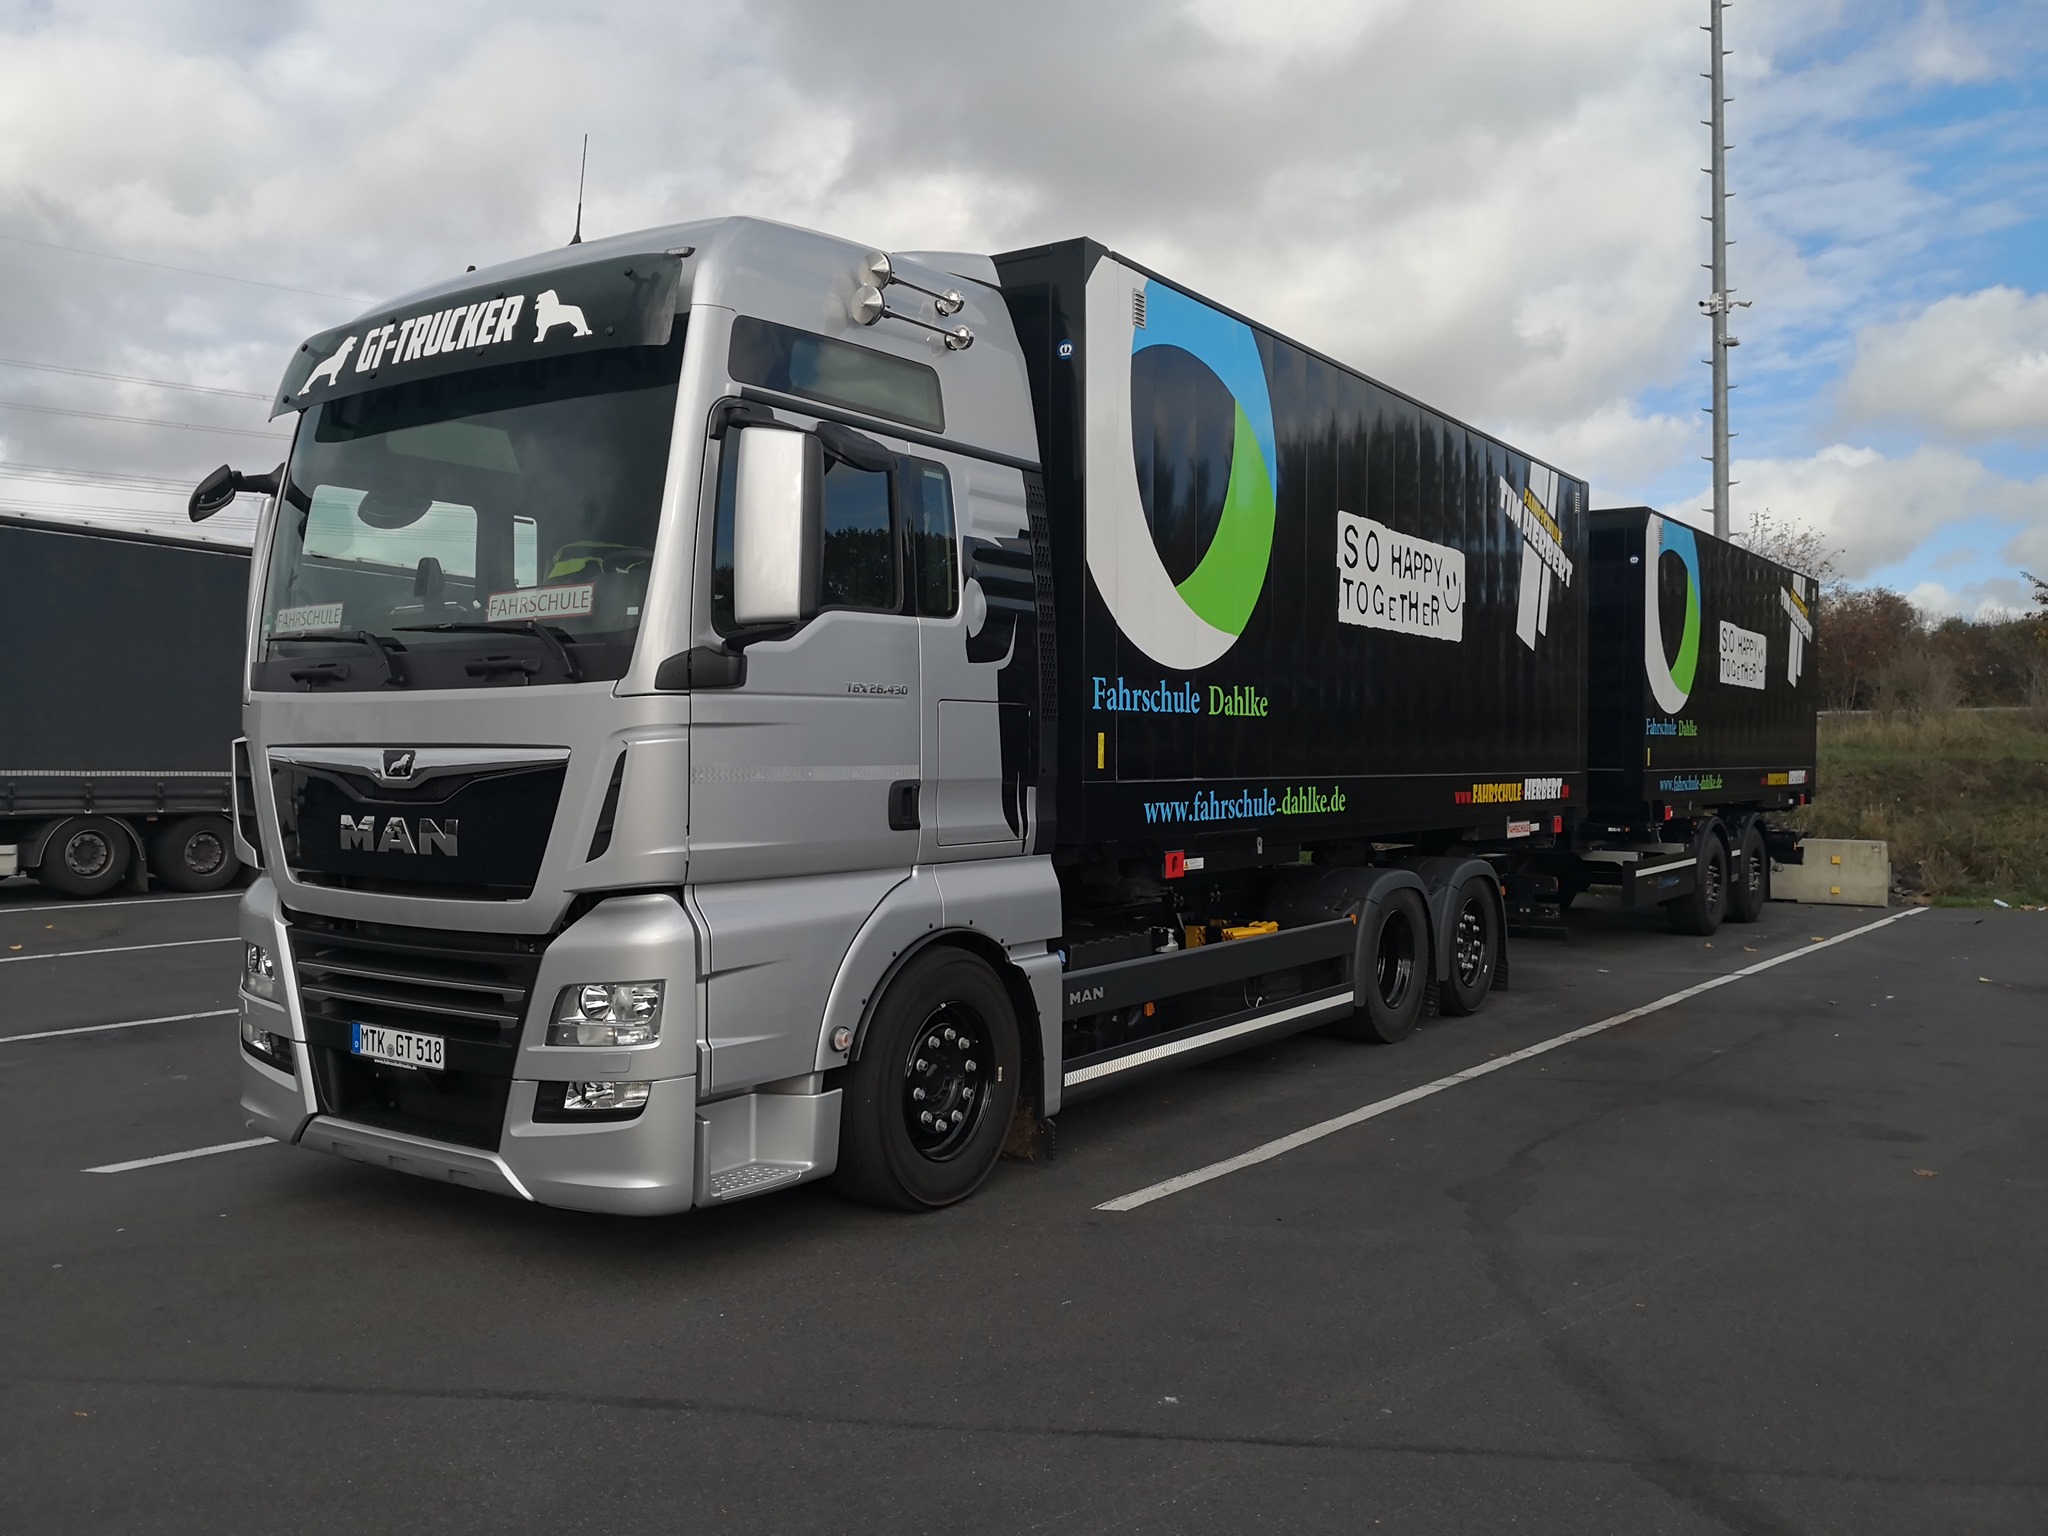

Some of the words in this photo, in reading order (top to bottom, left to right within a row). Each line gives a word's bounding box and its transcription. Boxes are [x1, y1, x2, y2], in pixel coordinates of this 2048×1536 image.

[355, 294, 525, 373] GT-TRUCKER
[1500, 475, 1523, 528] TIM
[1344, 524, 1380, 573] SO
[1391, 544, 1443, 587] HAPPY
[1522, 505, 1573, 588] HERBERT
[276, 607, 341, 628] FAHRSCHULE
[489, 590, 590, 617] FAHRSCHULE
[1342, 577, 1440, 626] TOGETHER
[1721, 627, 1735, 653] SO
[1737, 636, 1758, 658] HAPPY
[845, 682, 868, 693] TGX
[869, 684, 909, 695] 26.430
[1092, 676, 1200, 714] Fahrschule
[1208, 685, 1269, 717] Dahlke
[1645, 717, 1677, 735] Fahrschule
[1144, 785, 1346, 824] www.fahrschule-dahlke.de
[340, 814, 459, 857] MAN
[1069, 986, 1104, 1005] MAN
[361, 1028, 385, 1054] MTK
[396, 1034, 413, 1059] GT
[416, 1037, 442, 1064] 518
